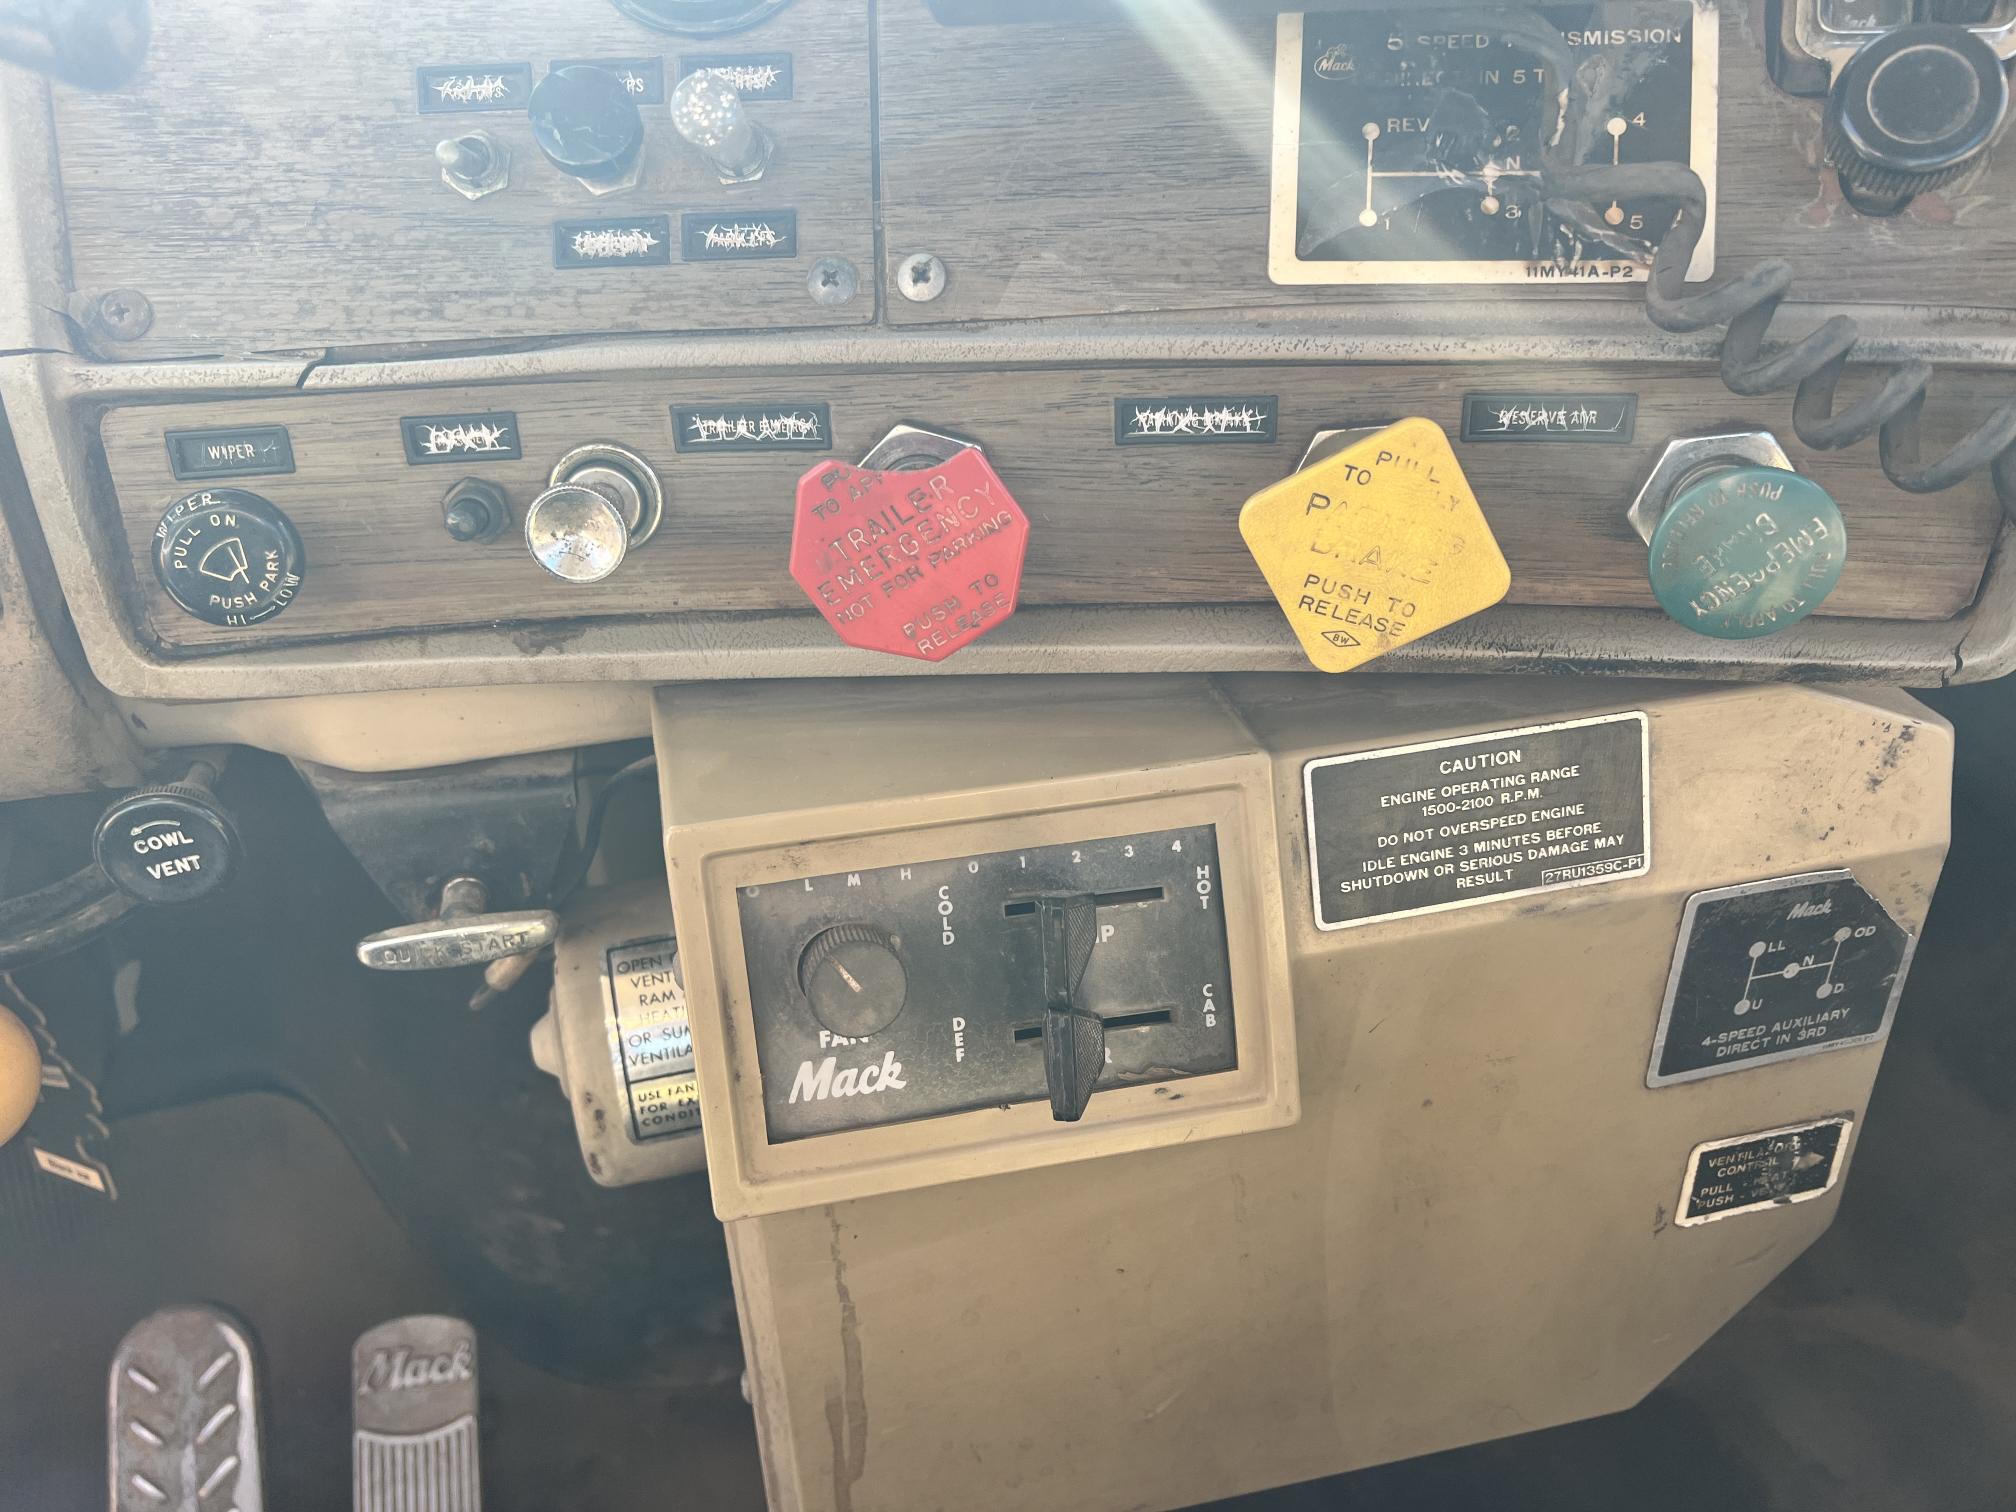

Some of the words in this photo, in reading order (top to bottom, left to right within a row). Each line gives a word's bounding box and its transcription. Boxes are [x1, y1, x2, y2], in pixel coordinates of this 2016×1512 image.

[1387, 34, 1404, 51] 5
[1417, 34, 1490, 49] SPEED
[1317, 57, 1356, 72] Mack
[1480, 70, 1499, 84] IN
[1387, 117, 1431, 133] REV
[1632, 112, 1646, 127] 4
[1506, 155, 1520, 170] N
[1505, 205, 1521, 219] 3
[1629, 215, 1643, 229] 5
[208, 443, 256, 460] WIPER
[1343, 464, 1372, 486] TO
[156, 492, 219, 538] WIPER
[811, 497, 842, 522] TO
[829, 474, 954, 561] TRAILER
[174, 527, 201, 569] PULL
[209, 514, 236, 528] ON
[817, 481, 999, 607] EMERGENCY
[209, 592, 258, 610] PUSH
[259, 549, 280, 592] PARK
[835, 594, 874, 625] NOT
[882, 566, 925, 598] FOR
[927, 510, 1014, 569] PARKING
[1688, 515, 1830, 618] EMERGENCY
[226, 615, 247, 625] HI
[274, 572, 301, 607] LOW
[902, 595, 962, 641] PUSH
[970, 573, 1000, 596] TO
[1303, 573, 1372, 606] PUSH
[1387, 596, 1417, 619] TO
[916, 594, 1013, 656] RELEASE
[1298, 594, 1407, 638] RELEASE
[1331, 634, 1351, 646] BW
[1439, 749, 1522, 775] CAUTION
[1380, 788, 1437, 808] ENGINE
[1441, 774, 1526, 799] OPERATING
[1530, 765, 1581, 784] RANGE
[1421, 795, 1494, 817] 1500-2100
[1501, 788, 1543, 804] R.P.M.
[1377, 835, 1399, 849] DO
[1403, 828, 1435, 844] NOT
[1439, 814, 1527, 838] OVERSPEED
[1531, 803, 1586, 823] ENGINE
[133, 828, 195, 856] COWL
[1018, 855, 1027, 870] 1
[1071, 849, 1083, 864] 2
[1123, 844, 1135, 858] 3
[1171, 839, 1183, 854] 4
[1362, 856, 1396, 873] IDLE
[1400, 847, 1455, 868] ENGINE
[1459, 845, 1469, 857] 3
[1473, 833, 1542, 854] MINUTES
[1546, 822, 1602, 842] BEFORE
[146, 855, 202, 880] VENT
[1340, 868, 1430, 894] SHUTDOWN
[1433, 863, 1455, 877] OR
[1459, 851, 1524, 873] SERIOUS
[1528, 840, 1590, 860] DAMAGE
[1594, 834, 1626, 850] MAY
[1456, 869, 1514, 890] RESULT
[1544, 857, 1643, 884] 27RU1359C-P1
[805, 878, 814, 893] L
[847, 872, 862, 888] M
[900, 867, 913, 882] H
[1196, 864, 1212, 911] HOT
[937, 885, 956, 947] COLD
[1786, 898, 1833, 921] Mack
[461, 930, 529, 955] START
[1853, 925, 1878, 938] OD
[1766, 939, 1787, 953] LL
[617, 955, 662, 975] OPEN
[1802, 954, 1815, 967] N
[638, 989, 676, 1008] RAM
[1833, 982, 1846, 995] D
[640, 1005, 687, 1024] HEATI
[1202, 983, 1217, 1029] CAB
[628, 1031, 652, 1049] OR
[662, 1026, 691, 1043] SUM
[952, 1016, 966, 1064] DEF
[1701, 1024, 1767, 1048] 4-SPEED
[1770, 1007, 1852, 1033] AUXILIARY
[1715, 1037, 1770, 1058] DIRECT
[1775, 1031, 1793, 1045] IN
[1797, 1026, 1829, 1042] 3RD
[628, 1044, 693, 1067] VENTILA
[788, 1050, 907, 1104] Mack
[638, 1090, 662, 1103] USE
[667, 1083, 695, 1097] FAN
[640, 1101, 668, 1116] FOR
[642, 1107, 700, 1128] CONDIT
[1696, 1194, 1735, 1210] PUSH
[1700, 1183, 1734, 1199] PULL
[357, 1341, 474, 1396] Mack
